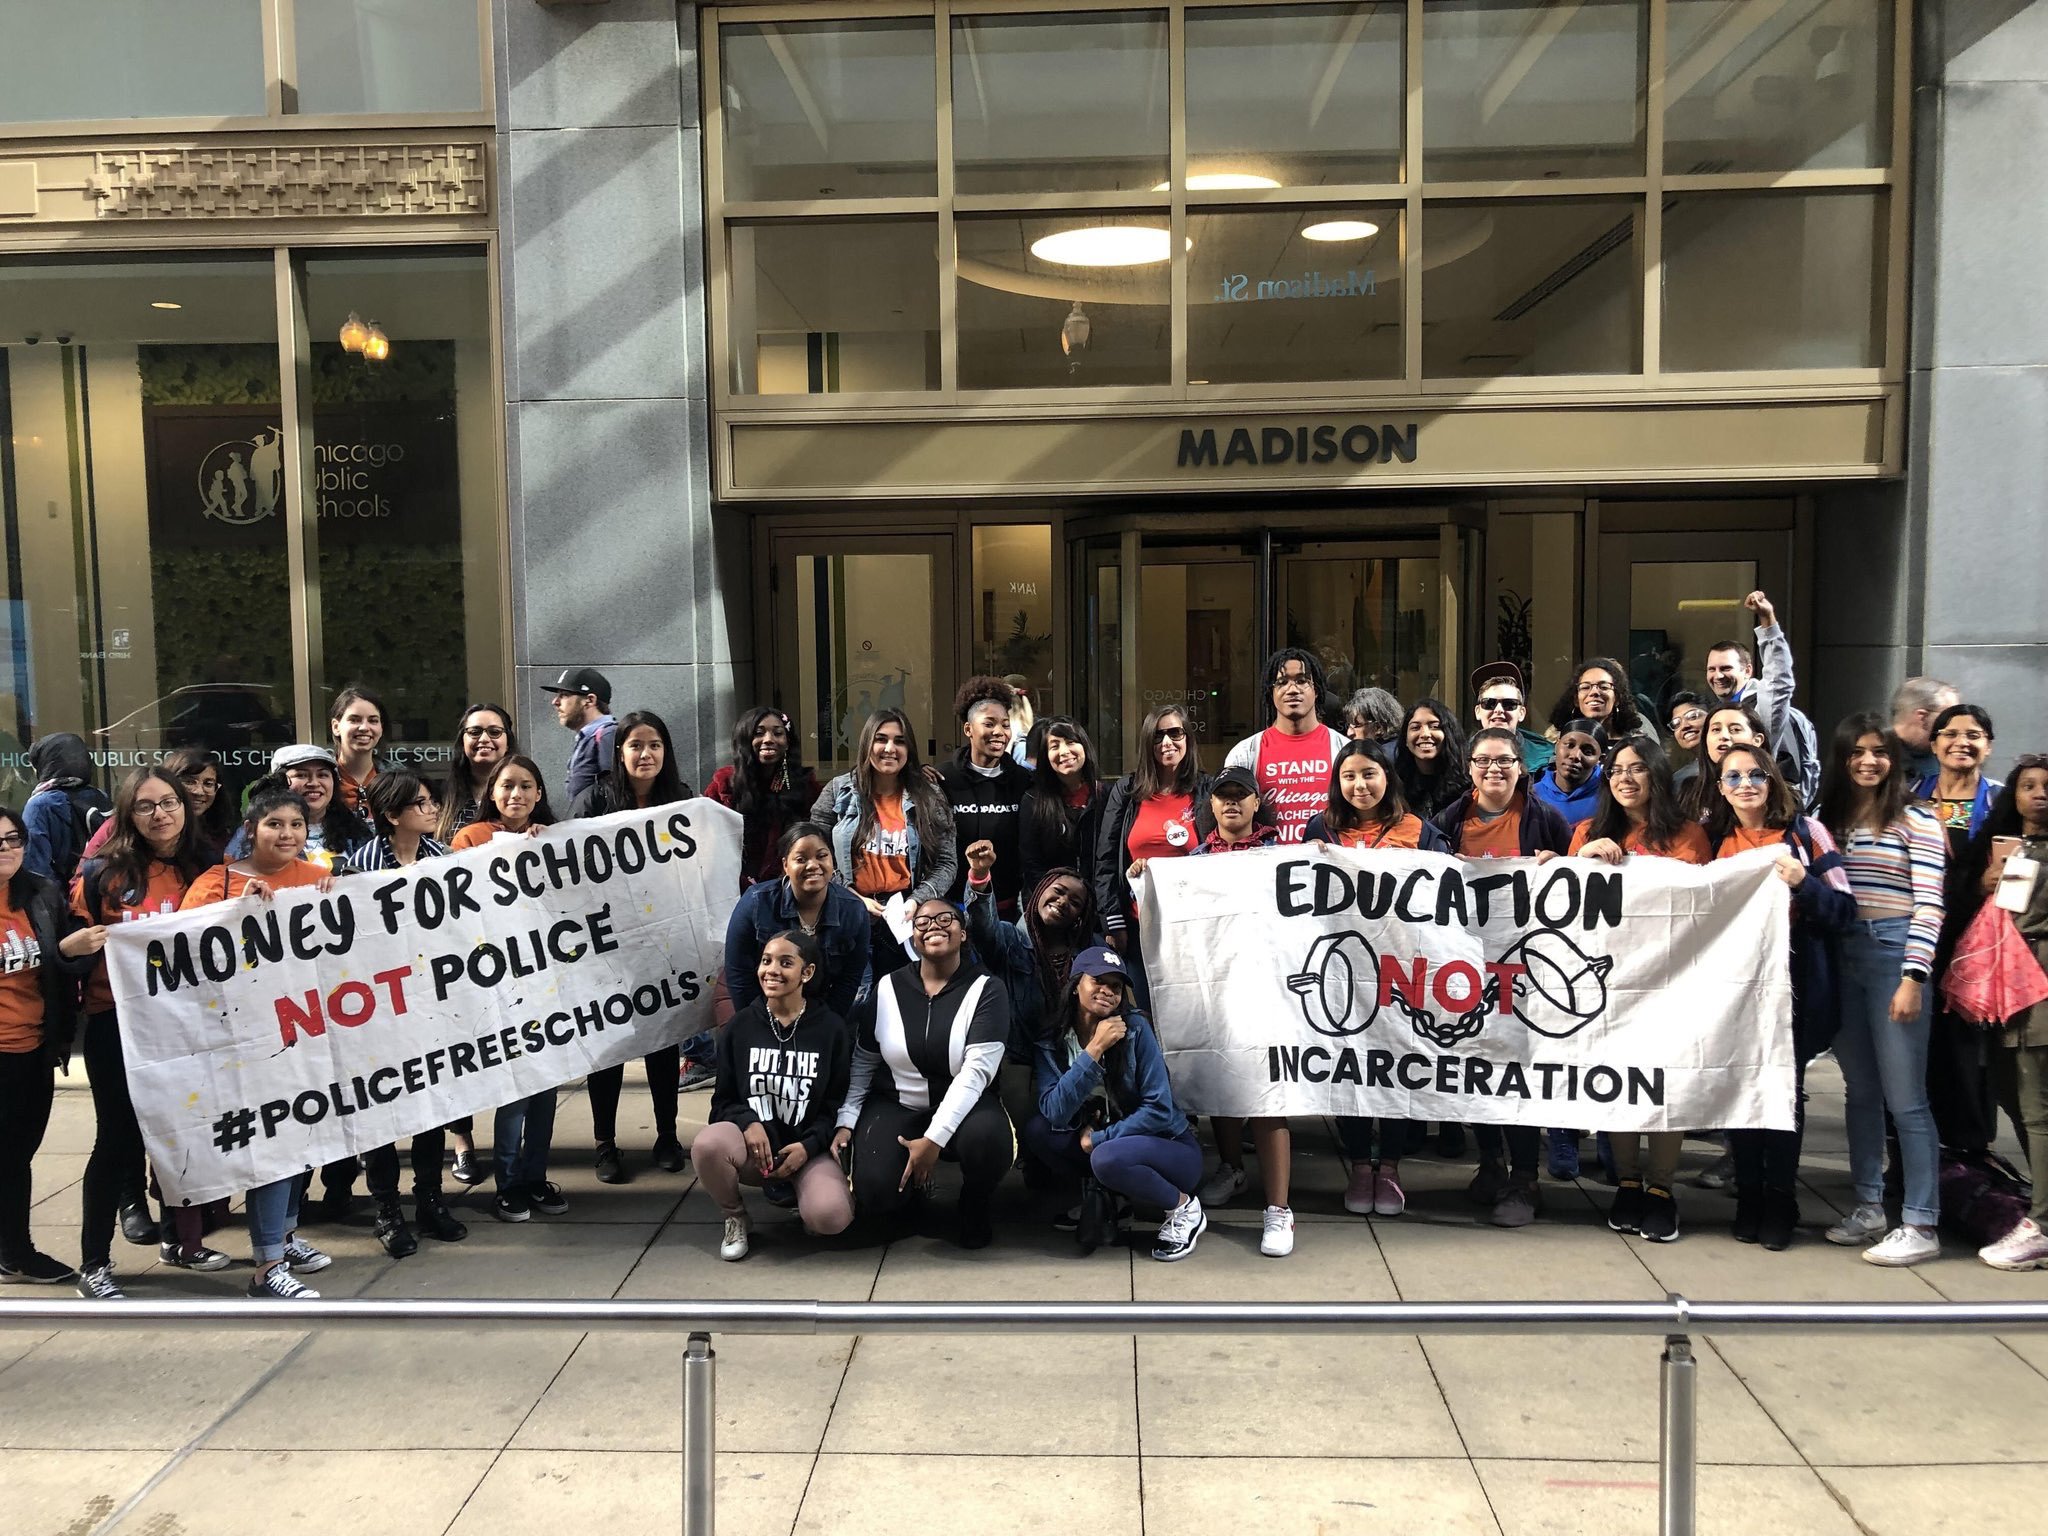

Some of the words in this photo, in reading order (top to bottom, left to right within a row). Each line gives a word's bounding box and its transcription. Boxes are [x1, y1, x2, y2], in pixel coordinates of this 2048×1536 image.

[314, 444, 404, 468] icago
[1177, 424, 1417, 467] MADISON
[316, 466, 369, 490] blic
[317, 494, 391, 517] hools
[1265, 760, 1328, 777] STAND
[1264, 788, 1329, 807] Chicago
[1275, 810, 1324, 821] ACHER
[146, 894, 356, 996] MONEY
[373, 866, 480, 934] FOR
[494, 813, 697, 907] SCHOOLS
[1275, 860, 1622, 929] EDUCATION
[274, 966, 412, 1048] NOT
[431, 904, 619, 1001] POLICE
[1378, 954, 1527, 1015] NOT
[748, 1047, 780, 1074] PUT
[785, 1050, 820, 1078] THE
[1269, 1045, 1665, 1105] INCARCERATION
[749, 1074, 813, 1101] GUNS
